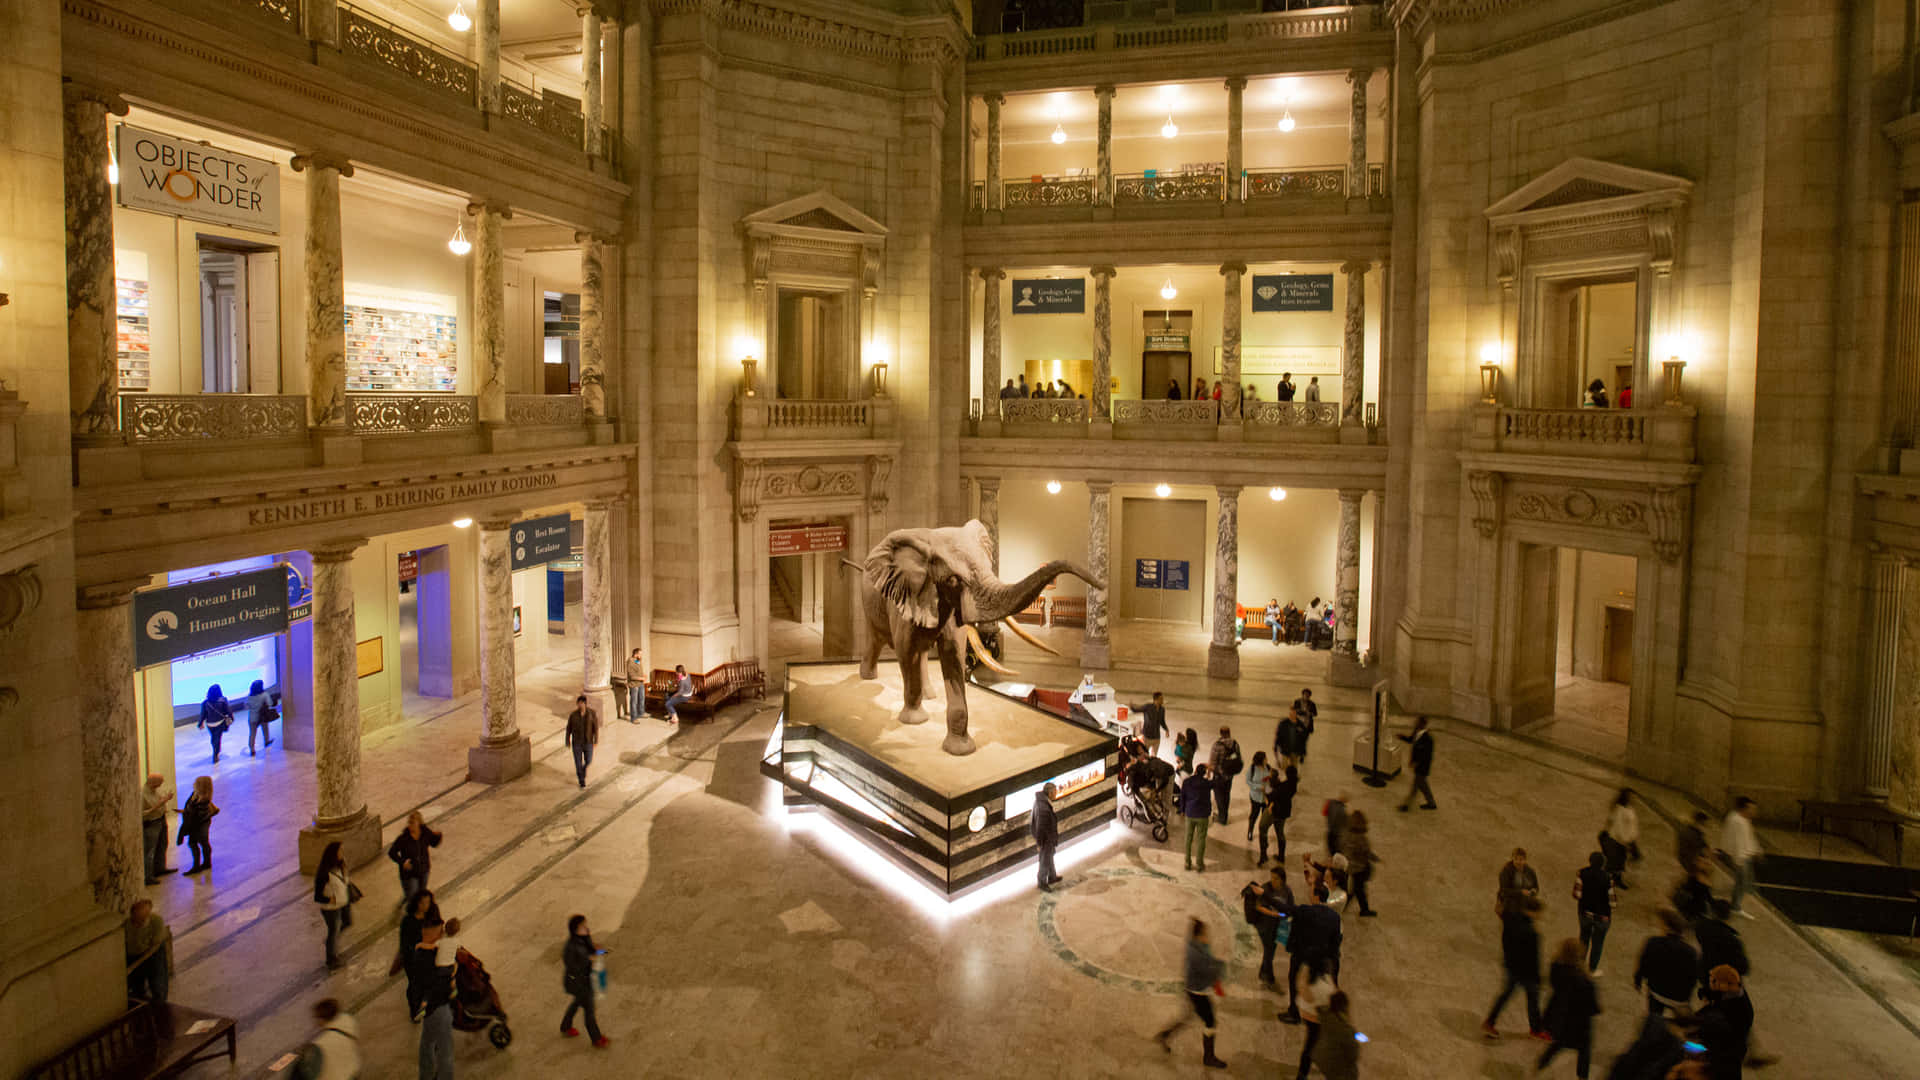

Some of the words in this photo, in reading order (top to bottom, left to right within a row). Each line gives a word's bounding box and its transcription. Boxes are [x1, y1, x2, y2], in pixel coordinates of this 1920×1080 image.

[136, 139, 248, 184] OBJECTS
[251, 172, 269, 190] of
[138, 166, 262, 212] WONDER
[248, 499, 345, 526] KENNETH
[354, 496, 368, 512] E.
[375, 487, 445, 509] BEHRING
[451, 480, 497, 498] FAMILY
[502, 473, 557, 491] ROTUNDA
[535, 543, 560, 555] Escalator
[187, 593, 227, 609] Ocean
[231, 584, 257, 600] Hall
[189, 614, 236, 633] Human
[239, 605, 281, 622] Origins
